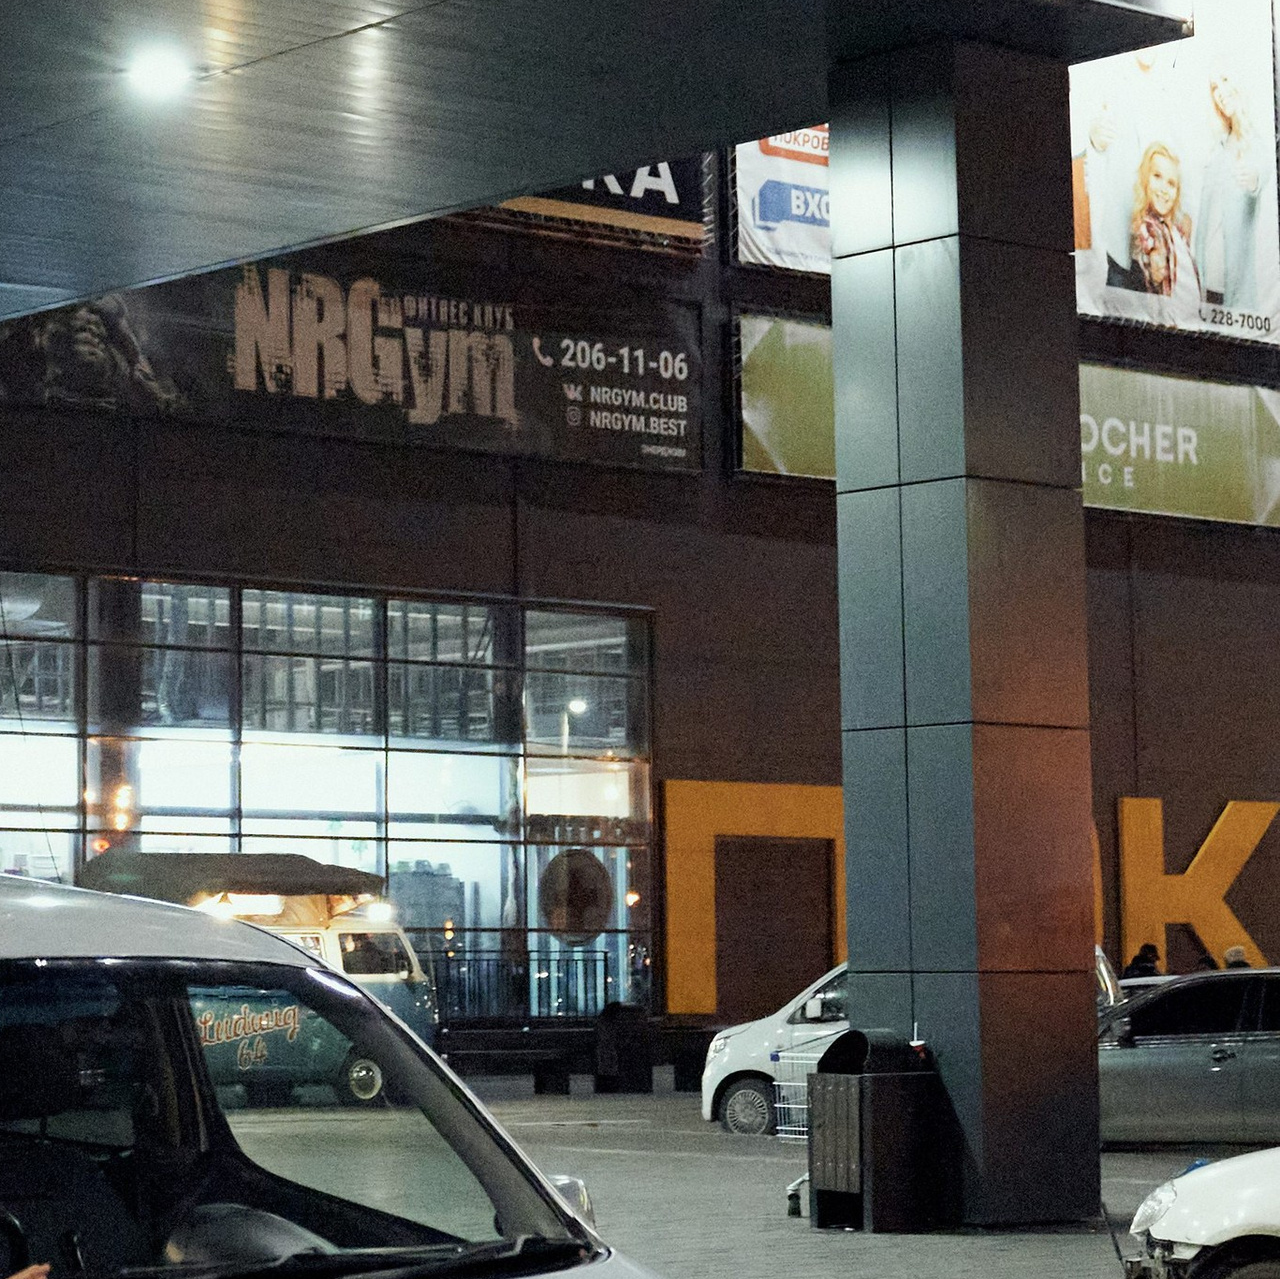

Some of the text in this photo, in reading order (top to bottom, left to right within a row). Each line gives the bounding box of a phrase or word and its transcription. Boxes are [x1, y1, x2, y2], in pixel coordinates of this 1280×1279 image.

[1211, 308, 1271, 333] 228-7000
[560, 338, 688, 380] 206-11-06
[590, 385, 687, 413] NRGYM.CLUB
[589, 409, 687, 436] NRGYM.BEST
[238, 1036, 267, 1070] 64
